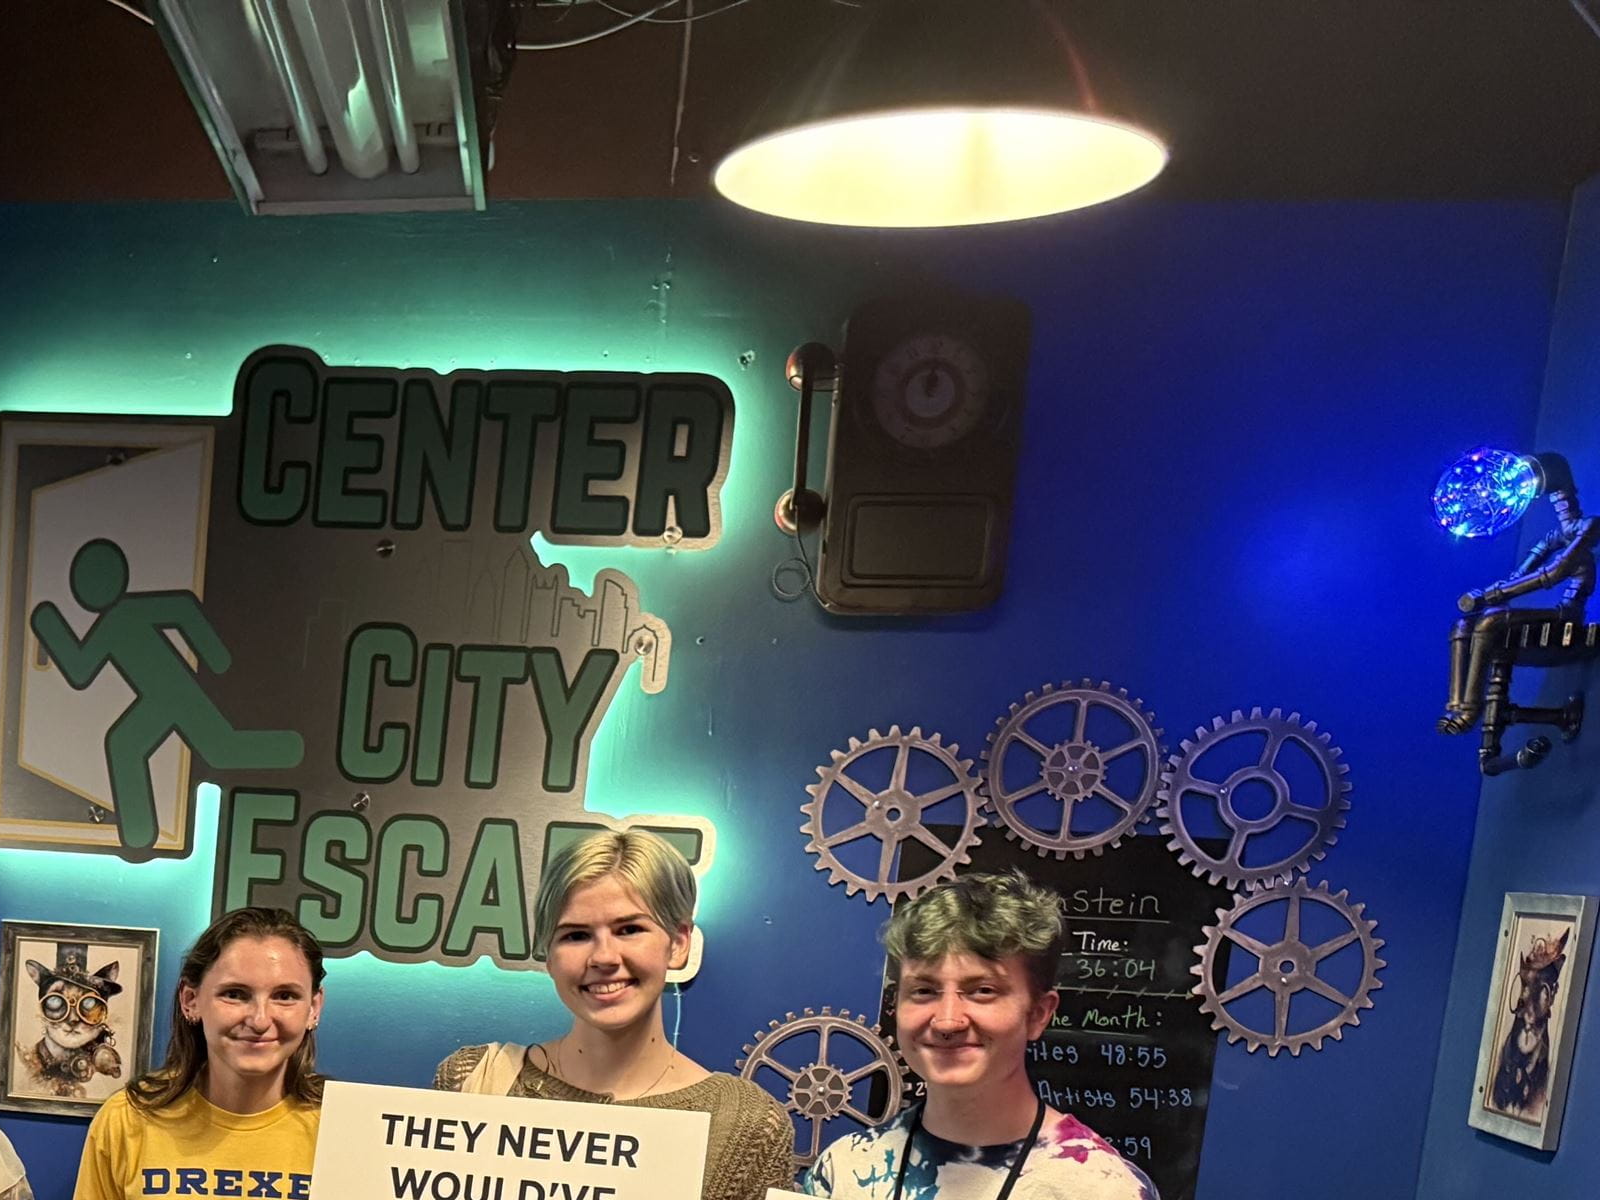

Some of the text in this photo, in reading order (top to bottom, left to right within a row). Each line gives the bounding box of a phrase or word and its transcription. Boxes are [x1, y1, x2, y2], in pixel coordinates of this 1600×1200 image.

[238, 355, 725, 538] CENTER
[336, 622, 619, 793] CITY
[225, 788, 703, 961] ESCA
[1072, 931, 1129, 952] Time:
[1076, 959, 1156, 981] 36:04
[1051, 1005, 1162, 1028] he Month:
[1027, 1041, 1167, 1069] ites 48:55
[1038, 1080, 1192, 1110] Artists 54:38
[381, 1113, 640, 1168] THEY NEVER
[142, 1168, 312, 1200] DREXE
